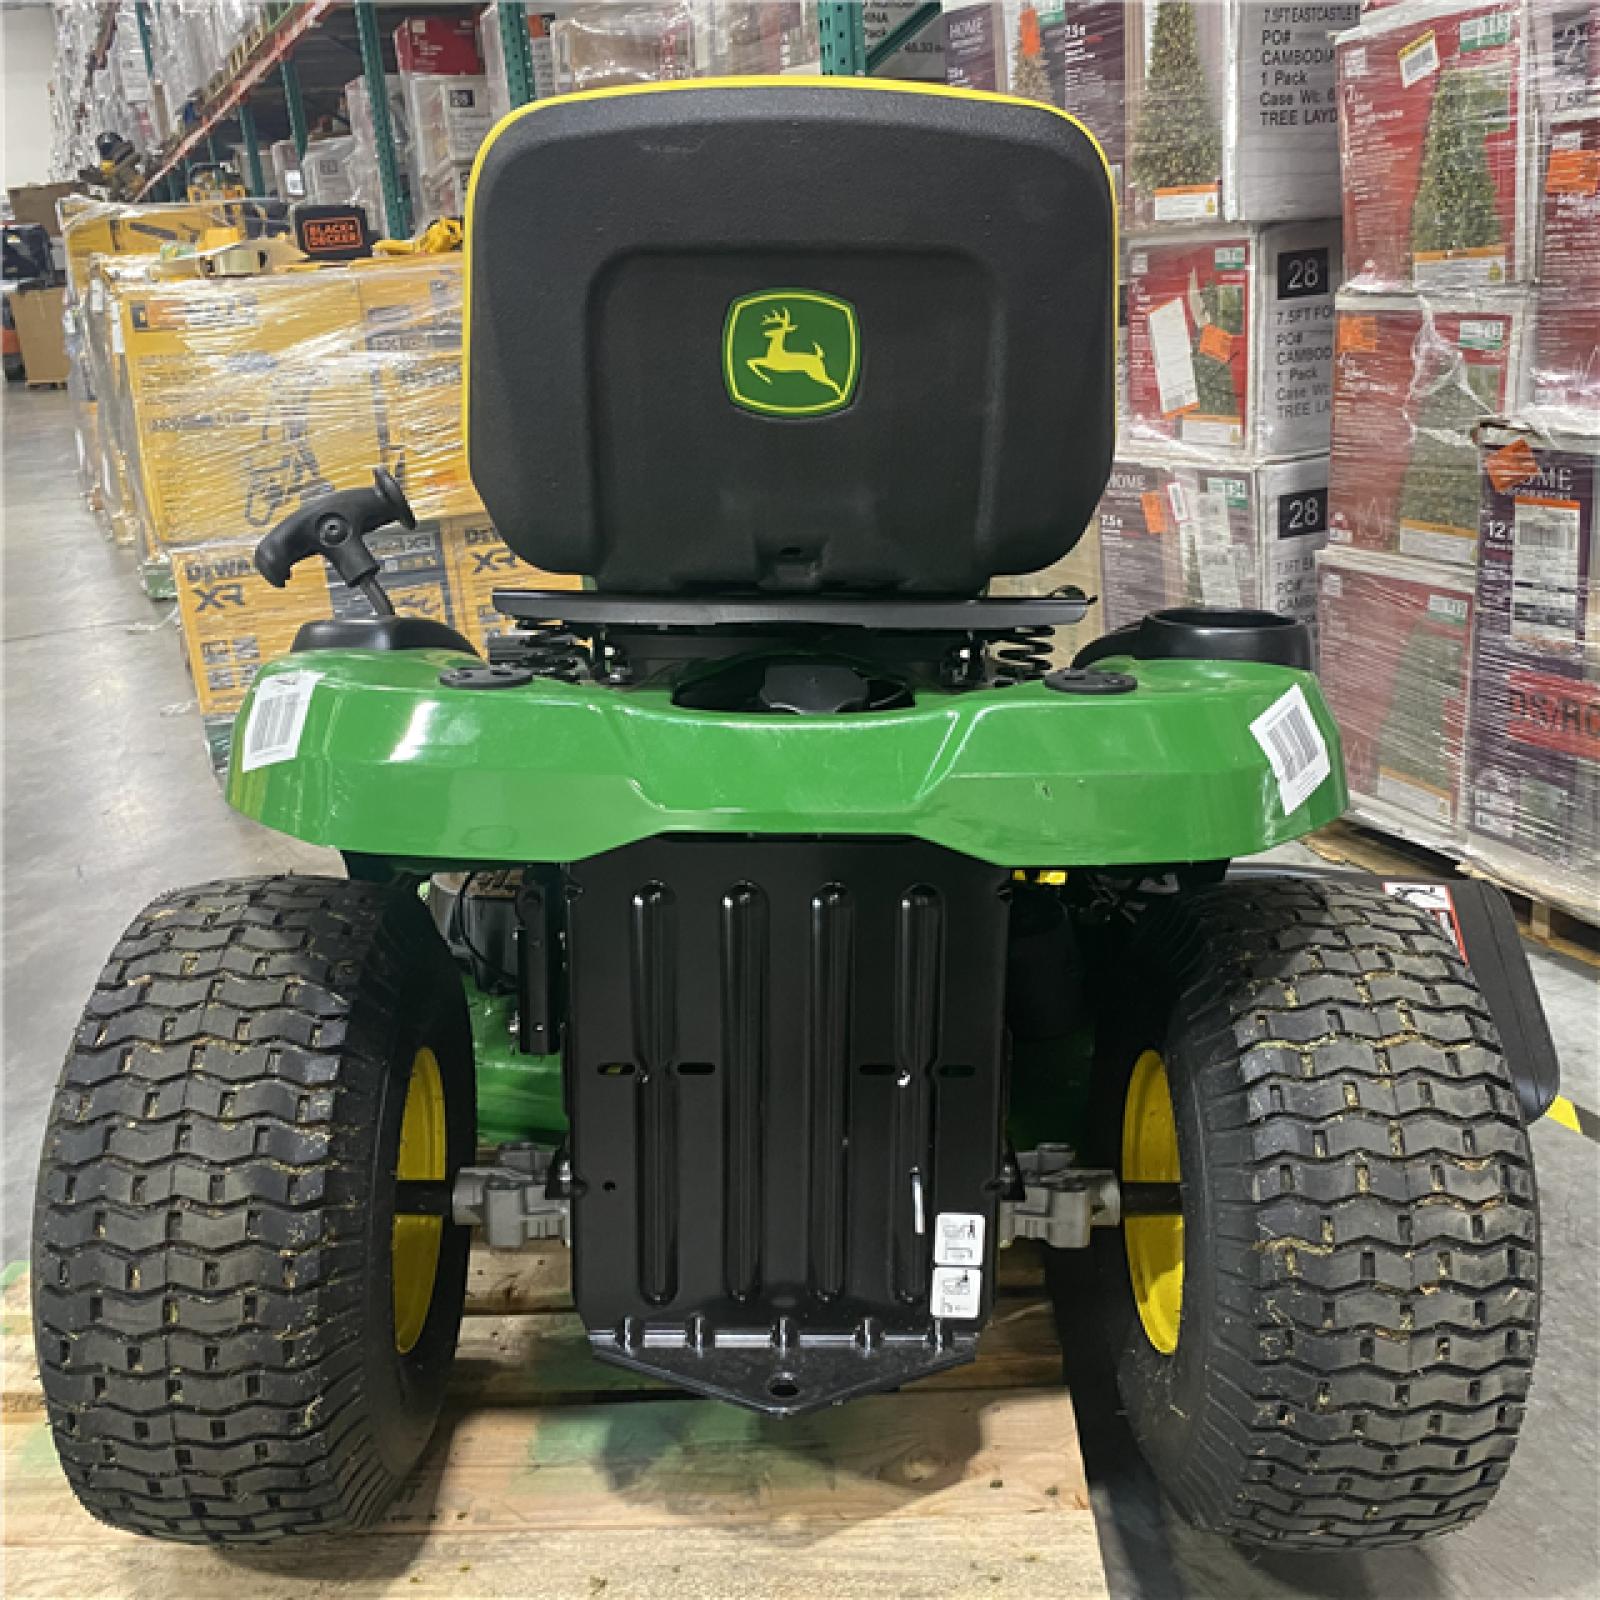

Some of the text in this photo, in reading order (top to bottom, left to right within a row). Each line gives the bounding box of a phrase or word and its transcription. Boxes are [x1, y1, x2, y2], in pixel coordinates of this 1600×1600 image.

[1262, 30, 1291, 45] PO#
[1274, 69, 1306, 86] Pack
[1260, 91, 1293, 106] Case
[1260, 109, 1298, 126] TREE
[1287, 258, 1319, 290] 28
[1276, 332, 1303, 345] PO#
[1276, 402, 1311, 418] TREE
[1288, 497, 1318, 529] 28
[1489, 520, 1506, 539] 12
[193, 584, 246, 613] XR
